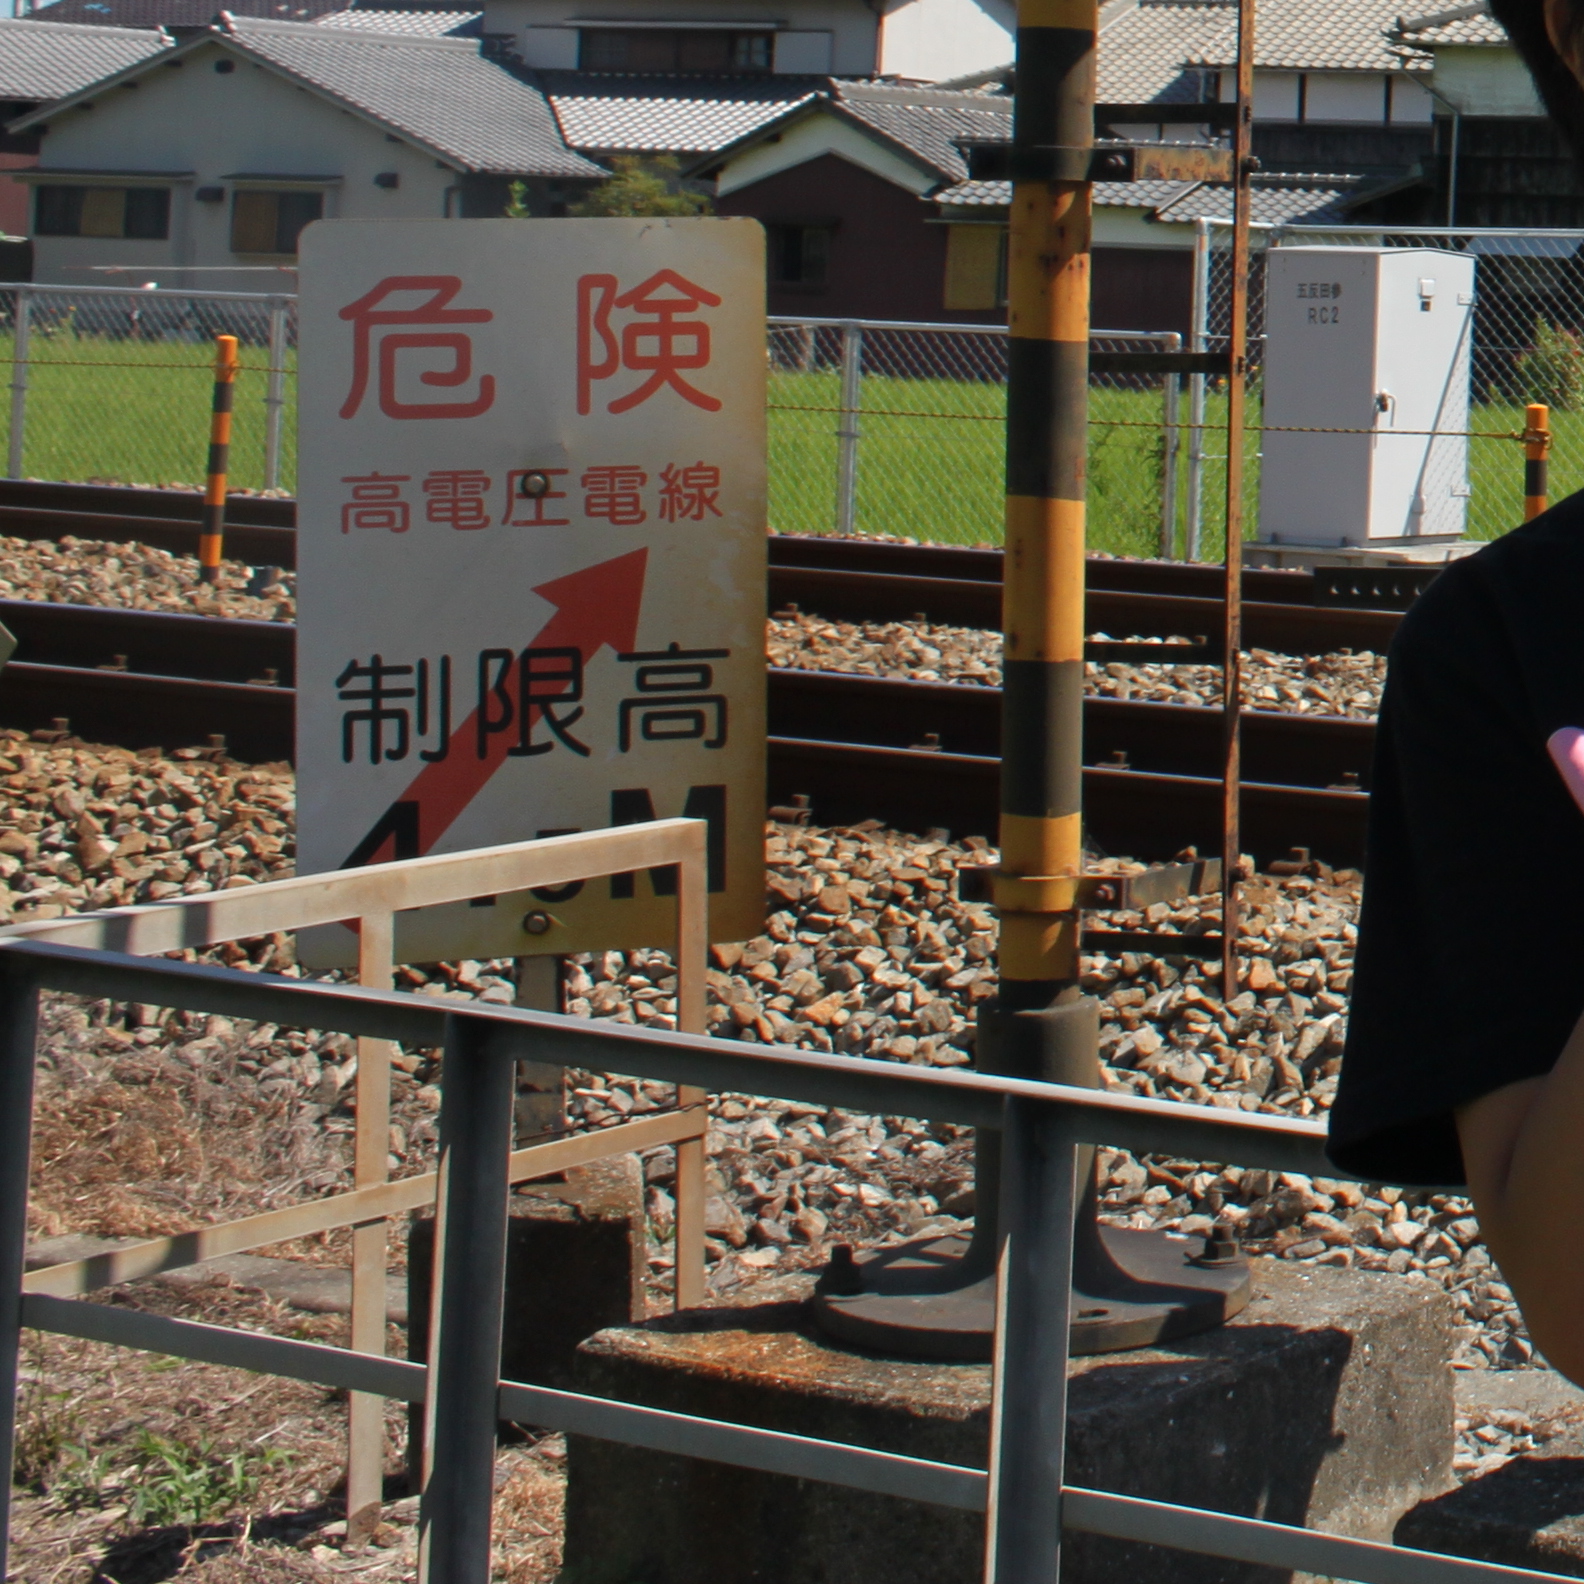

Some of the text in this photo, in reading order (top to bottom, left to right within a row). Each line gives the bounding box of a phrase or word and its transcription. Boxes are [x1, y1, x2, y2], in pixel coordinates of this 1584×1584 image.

[338, 268, 722, 421] 危険
[340, 460, 723, 534] 高電圧電線
[335, 641, 731, 766] 制限高
